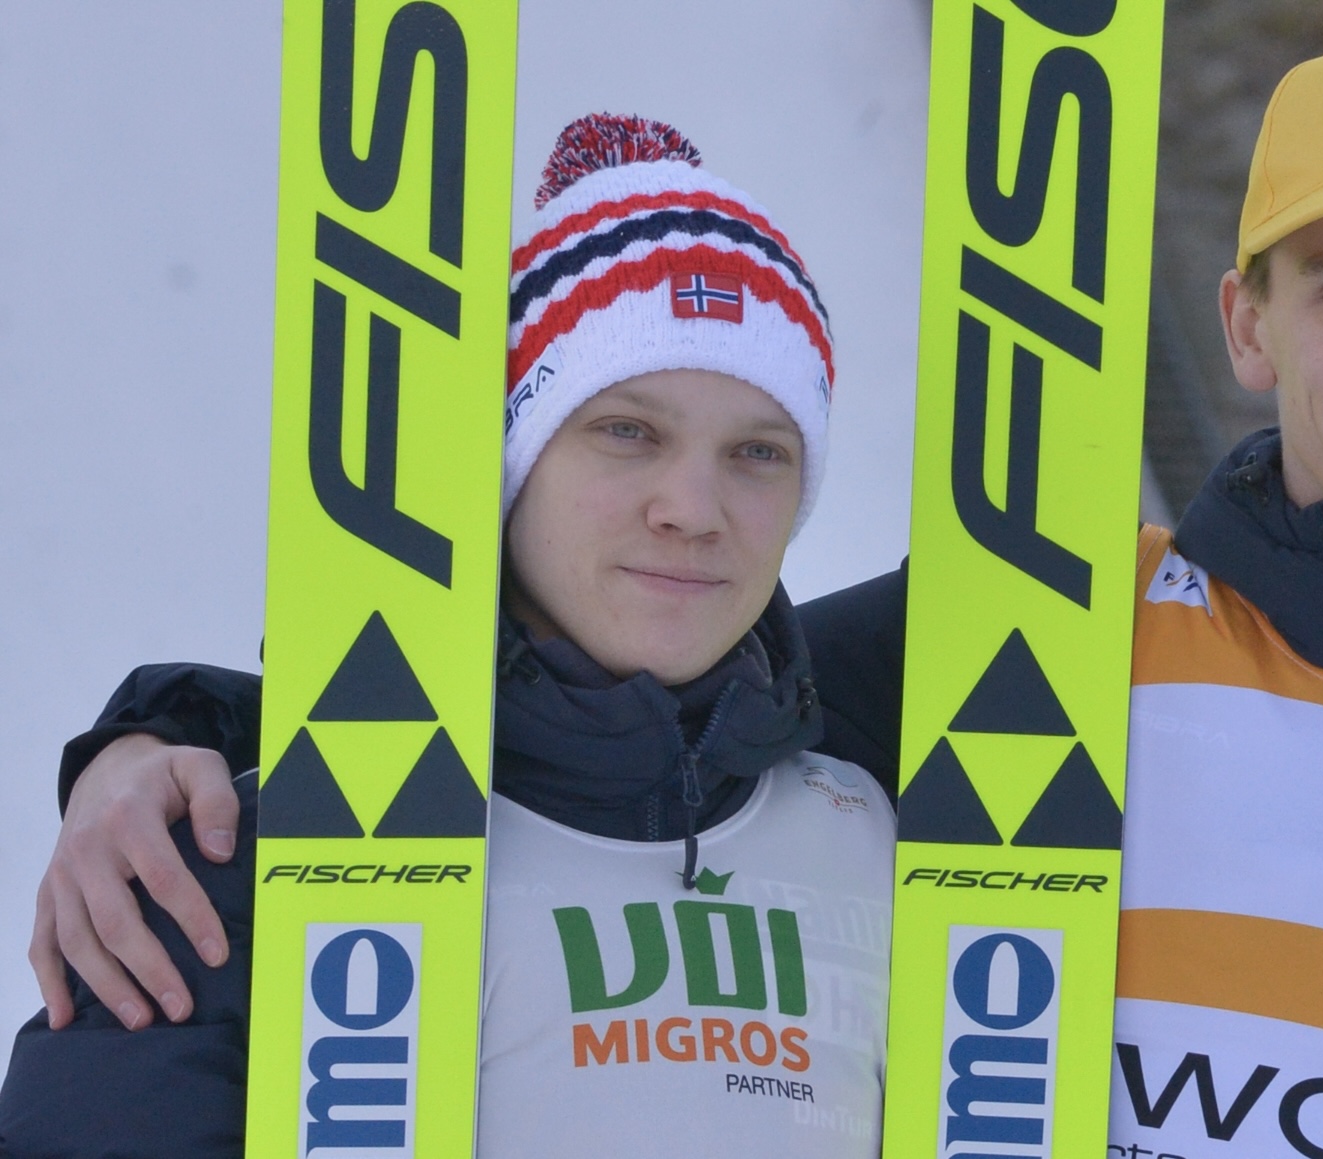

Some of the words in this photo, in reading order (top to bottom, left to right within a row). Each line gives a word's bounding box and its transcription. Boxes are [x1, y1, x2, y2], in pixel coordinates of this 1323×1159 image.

[263, 865, 472, 884] FISCHER
[903, 868, 1108, 893] FISCHER
[573, 1016, 811, 1072] MIGROS
[726, 1074, 814, 1103] PARTNER
